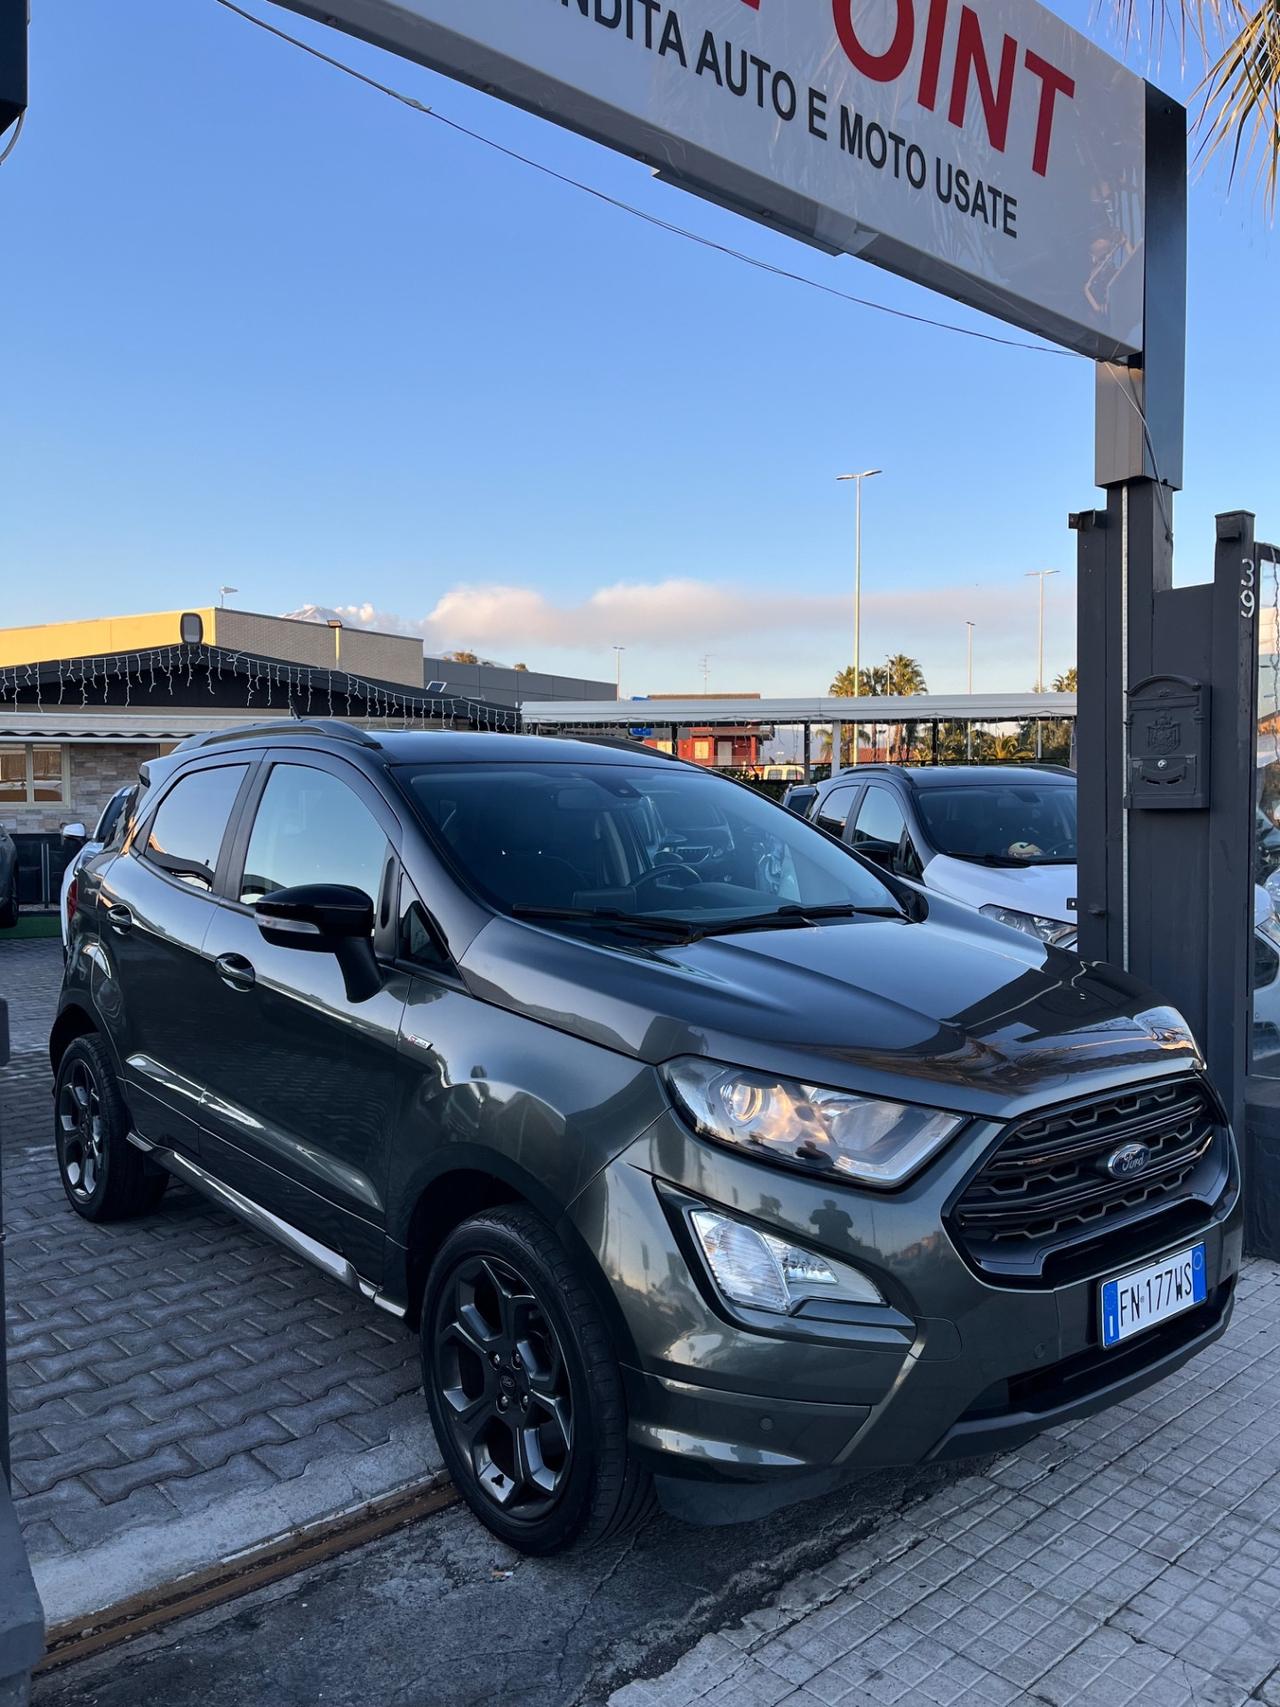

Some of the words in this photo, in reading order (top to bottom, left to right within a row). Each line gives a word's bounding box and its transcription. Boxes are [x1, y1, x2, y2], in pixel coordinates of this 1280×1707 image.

[561, 0, 687, 68] DITA
[695, 29, 796, 121] AUTO
[808, 86, 828, 141] E
[839, 104, 926, 189] MOTO
[936, 156, 1018, 239] USATE
[740, 0, 1075, 177] OINT
[1240, 558, 1256, 618] 39
[1121, 1150, 1146, 1171] Ford
